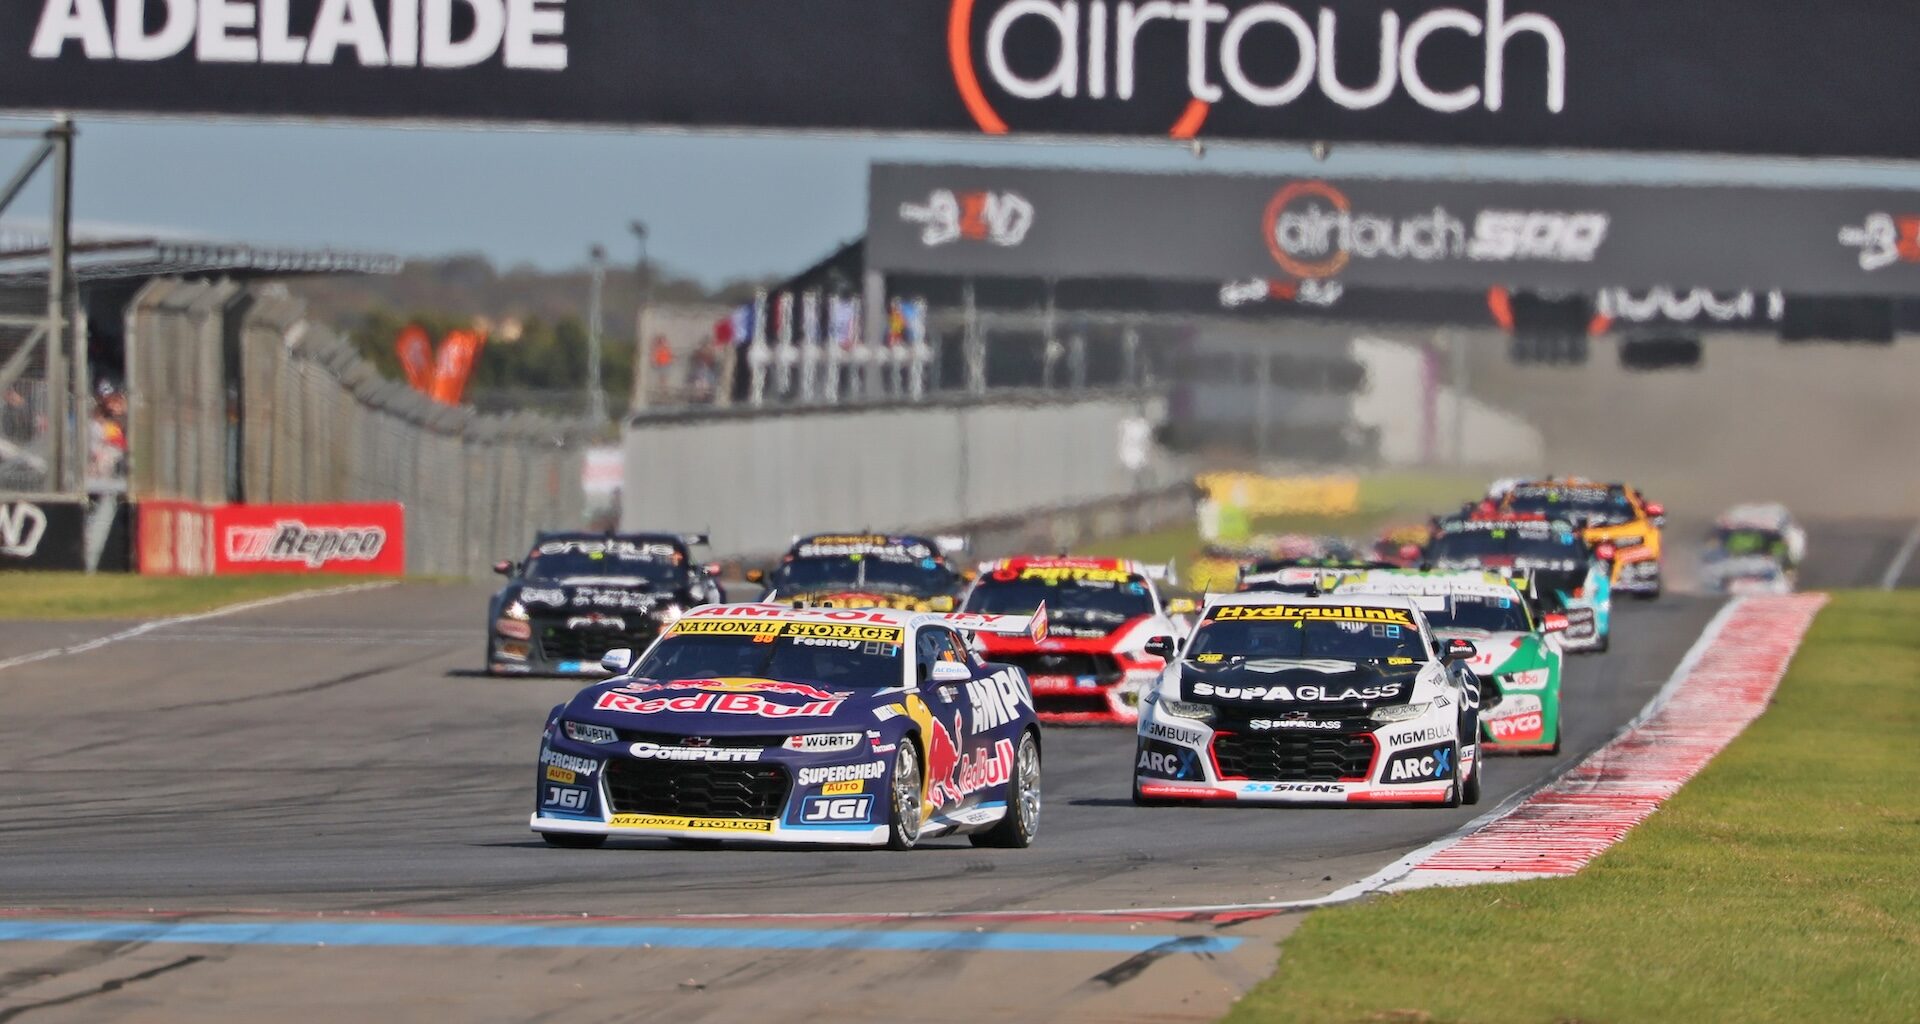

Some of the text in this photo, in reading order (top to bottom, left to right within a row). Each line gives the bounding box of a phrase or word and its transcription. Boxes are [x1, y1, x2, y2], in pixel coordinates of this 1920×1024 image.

[30, 0, 568, 71] ADELAIDE
[986, 0, 1566, 114] airtouch
[1274, 203, 1611, 262] airtouch 500
[272, 523, 388, 566] Repco
[1217, 605, 1407, 621] Hydraulink
[674, 621, 894, 640] NATIONAL STORAGE
[753, 634, 775, 644] 88
[793, 636, 861, 651] Feeney
[1193, 683, 1402, 701] SUPAGLASS
[594, 691, 712, 714] Red
[712, 694, 849, 717] Bull
[577, 724, 613, 741] WÜRTH
[1272, 721, 1341, 730] SUPAGLASS
[1490, 715, 1541, 736] RYCO
[806, 736, 854, 746] WÜRTH
[629, 742, 763, 761] COMPLETE
[549, 768, 573, 781] AUTO
[798, 760, 886, 785] SUPERCHEAP
[826, 783, 859, 791] AUTO
[544, 787, 588, 809] JGI
[806, 799, 868, 820] JGI
[610, 817, 767, 831] NATIONAL STORAGE
